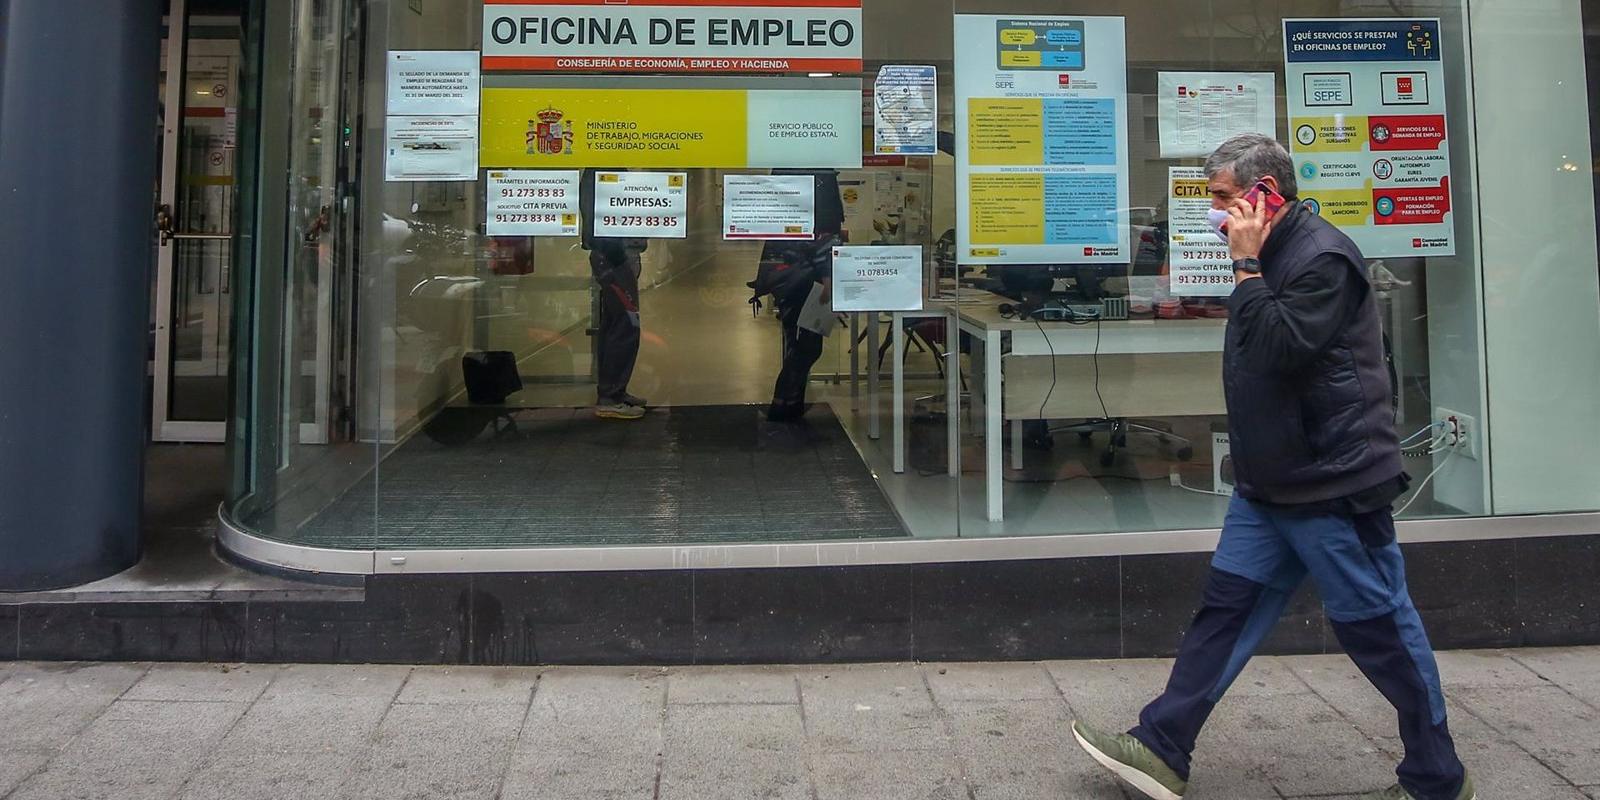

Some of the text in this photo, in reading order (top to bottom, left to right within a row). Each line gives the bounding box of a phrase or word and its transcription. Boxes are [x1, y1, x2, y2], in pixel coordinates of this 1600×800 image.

[491, 16, 854, 47] OFICINA DE EMPLEO
[1292, 31, 1311, 41] ¿QUÉ
[557, 58, 617, 68] CONSEJERÍA
[634, 58, 688, 69] ECONOMÍA,
[691, 60, 729, 68] EMPLEO
[740, 61, 790, 69] HACIENDA
[1314, 91, 1342, 101] SEPE
[600, 132, 640, 141] TRABAJO,
[502, 189, 564, 197] 91 273 83 83
[1175, 186, 1201, 196] CITA
[610, 198, 671, 207] EMPRESAS:
[604, 216, 677, 226] 91 273 83 85
[1183, 251, 1226, 259] 91 273 83
